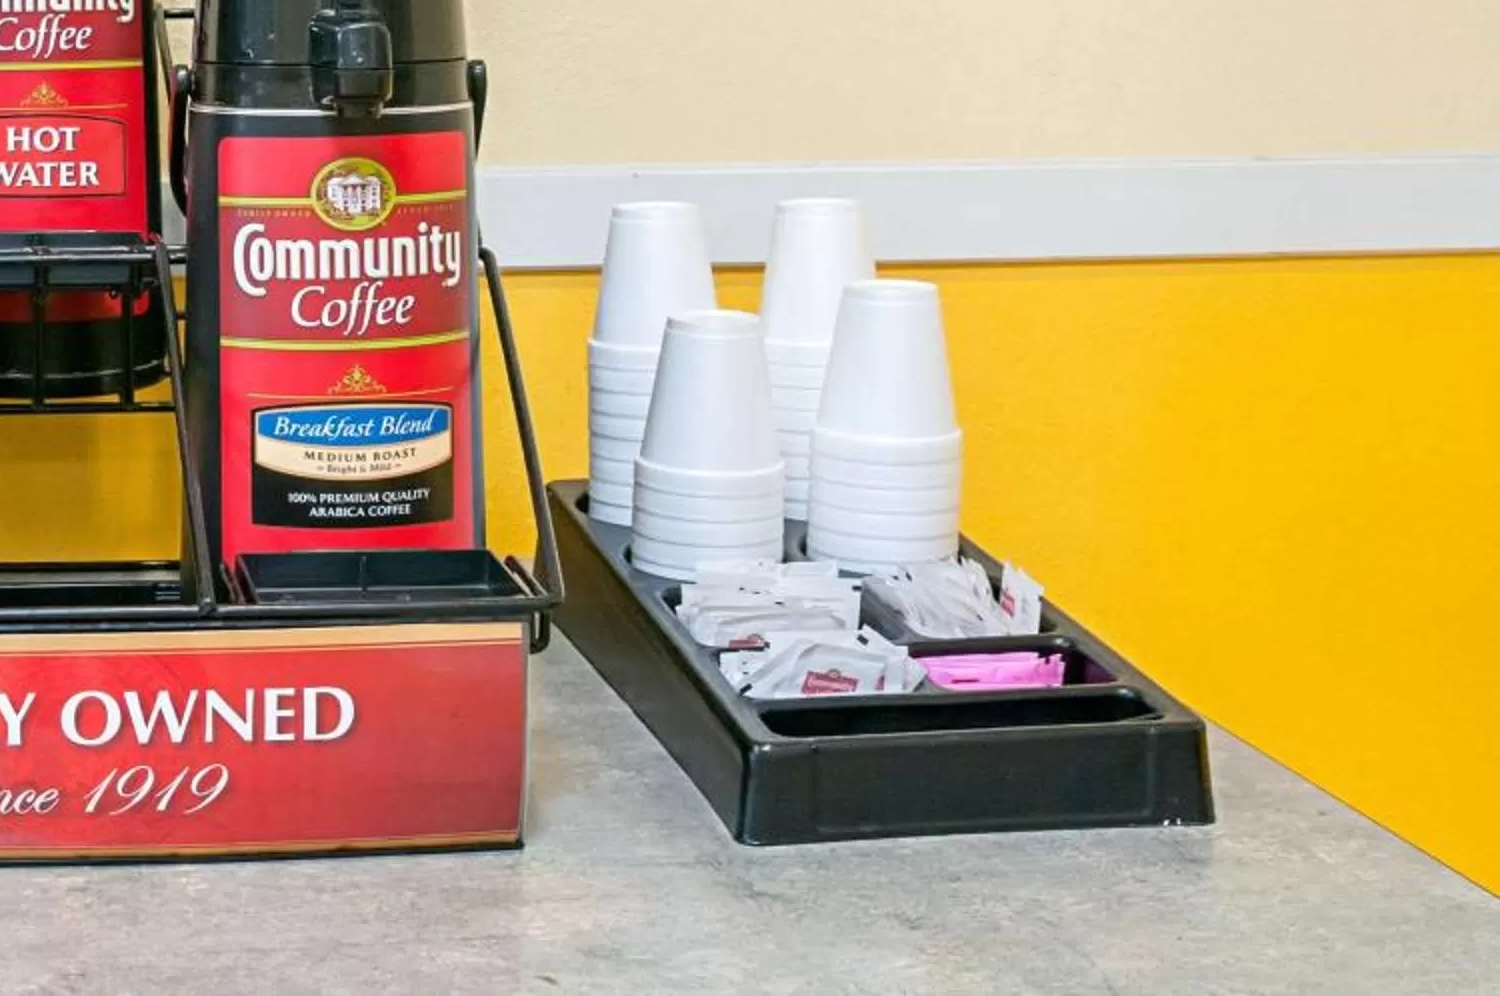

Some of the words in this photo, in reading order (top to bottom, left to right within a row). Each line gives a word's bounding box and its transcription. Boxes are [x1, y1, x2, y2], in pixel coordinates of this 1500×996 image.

[5, 126, 82, 153] HOT
[233, 221, 463, 296] Community
[290, 281, 416, 336] Coffee
[274, 414, 375, 441] Breakfast
[379, 408, 437, 436] Blend
[303, 450, 368, 462] MEDIUM
[373, 447, 417, 462] ROAST
[287, 492, 317, 504] 100%
[319, 492, 380, 504] PREMIUM
[381, 488, 431, 503] QUALITY
[308, 506, 365, 517] ARABICA
[368, 504, 412, 517] COFFEE
[59, 686, 357, 745] OWNED
[80, 764, 230, 815] 1919
